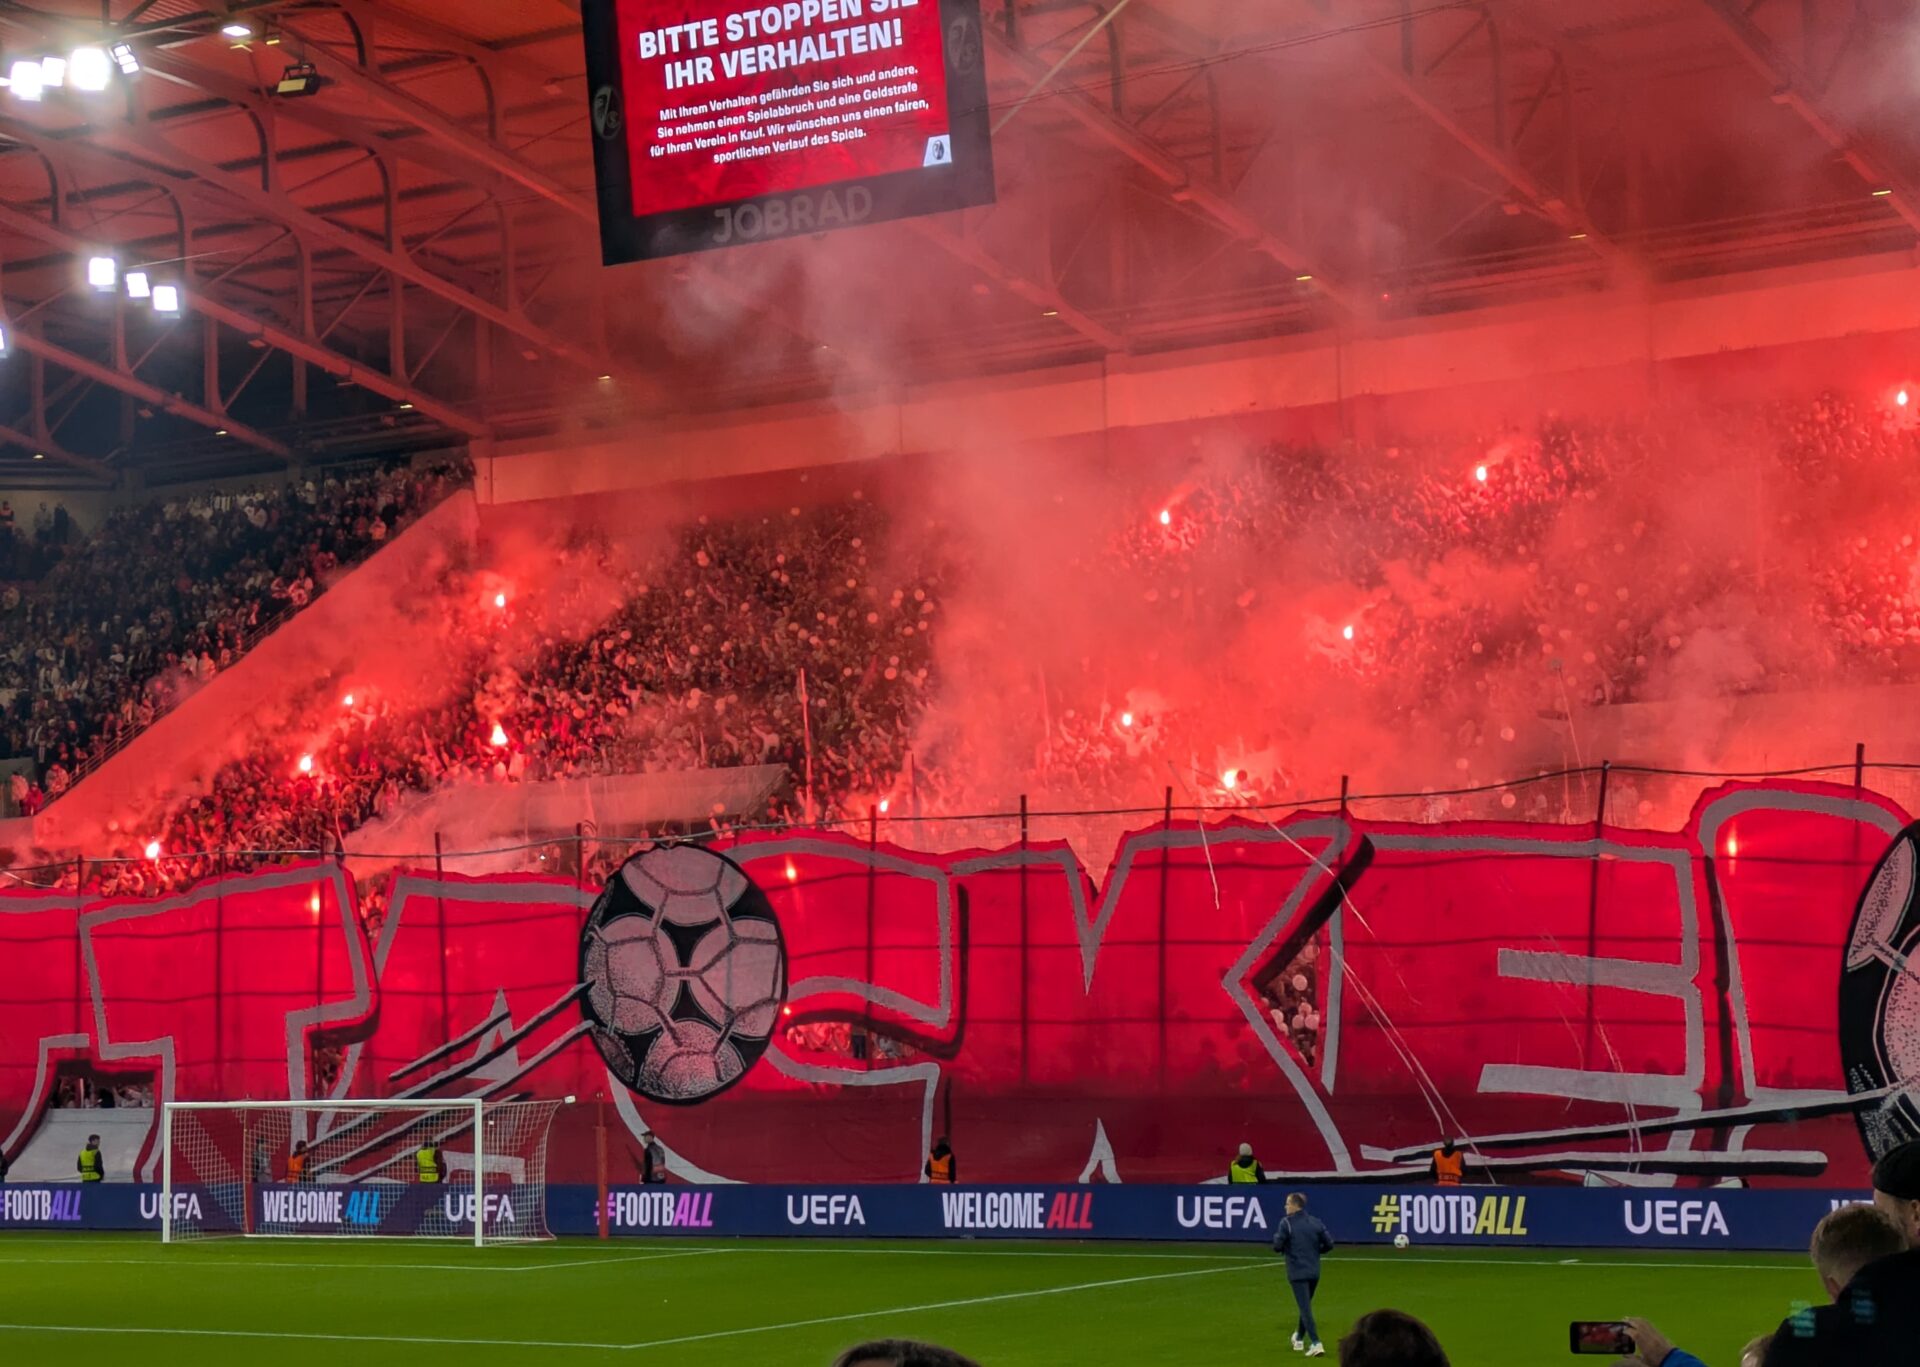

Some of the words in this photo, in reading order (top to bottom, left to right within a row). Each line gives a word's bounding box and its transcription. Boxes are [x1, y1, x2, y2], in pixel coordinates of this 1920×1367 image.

[639, 19, 719, 59] BITTE
[726, 0, 862, 41] STOPPEN
[665, 56, 715, 90] IHR
[720, 18, 903, 79] VERHALTEN!
[657, 127, 673, 138] Sie
[675, 121, 715, 135] nehmen
[717, 114, 745, 127] einen
[747, 101, 814, 123] Spielabbruch
[816, 96, 836, 109] und
[838, 93, 861, 106] eine
[863, 82, 918, 101] Geldstrafe
[660, 109, 677, 121] Mit
[679, 104, 708, 117] Ihrem
[709, 95, 757, 112] Verhalten
[760, 85, 811, 104] gefährden
[813, 81, 829, 93] Sie
[832, 76, 853, 89] sich
[856, 70, 876, 84] und
[878, 65, 918, 80] andere.
[650, 145, 664, 157] für
[666, 141, 693, 154] Ihren
[694, 135, 727, 149] Verein
[728, 132, 738, 144] in
[740, 127, 766, 141] Kauf.
[766, 124, 785, 136] Wir
[787, 116, 840, 133] wünschen
[841, 111, 861, 123] uns
[863, 105, 893, 119] einen
[895, 99, 929, 113] fairen,
[713, 145, 771, 164] sportlichen
[772, 135, 808, 153] Verlauf
[811, 134, 829, 147] des
[831, 127, 867, 144] Spiels.
[712, 186, 873, 244] JOBRAD
[0, 1190, 81, 1221] FOOTBALL
[263, 1190, 343, 1224] WELCOME
[345, 1190, 381, 1225] ALL
[445, 1194, 515, 1223] UEFA
[786, 1195, 866, 1226] UEFA
[942, 1192, 1045, 1230] WELCOME
[1046, 1192, 1094, 1231] ALL
[1176, 1196, 1268, 1230] UEFA
[1371, 1194, 1528, 1237] #FOOTBALL
[1623, 1199, 1730, 1237] UEFA
